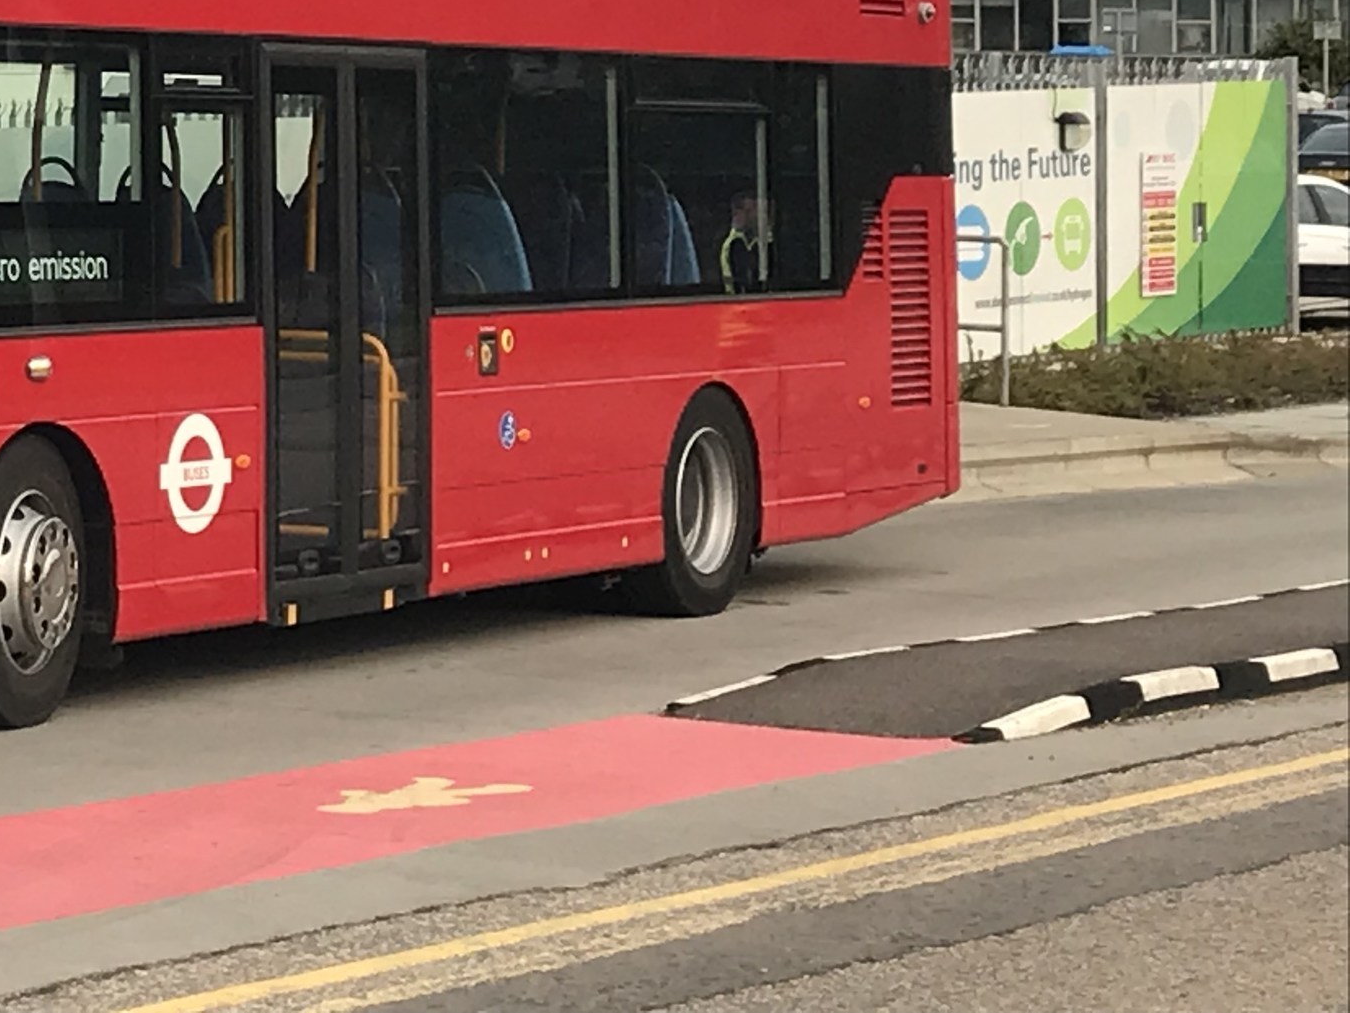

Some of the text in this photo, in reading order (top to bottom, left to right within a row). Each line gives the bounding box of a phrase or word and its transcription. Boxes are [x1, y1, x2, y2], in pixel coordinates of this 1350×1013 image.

[988, 148, 1022, 183] the
[1027, 147, 1092, 180] Future
[28, 249, 109, 281] emission
[183, 466, 210, 482] BUSES
